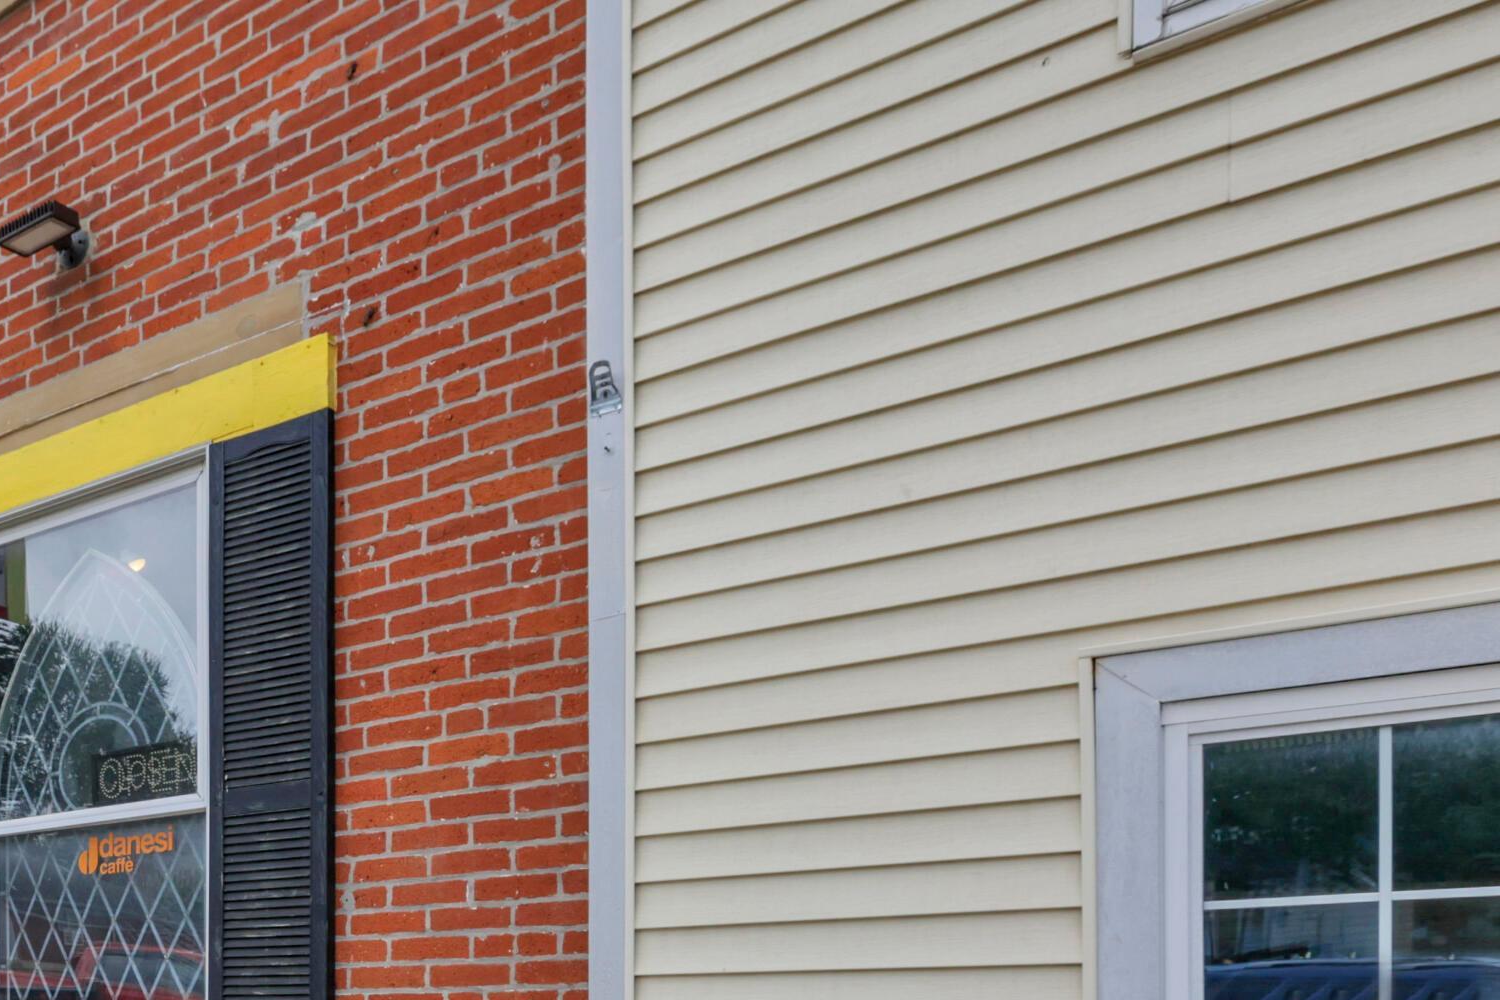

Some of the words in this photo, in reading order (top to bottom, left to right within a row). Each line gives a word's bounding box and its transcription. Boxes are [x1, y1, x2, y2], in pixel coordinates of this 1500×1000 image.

[100, 745, 199, 799] OPEN
[99, 823, 175, 858] danesi
[99, 855, 134, 876] caffè
